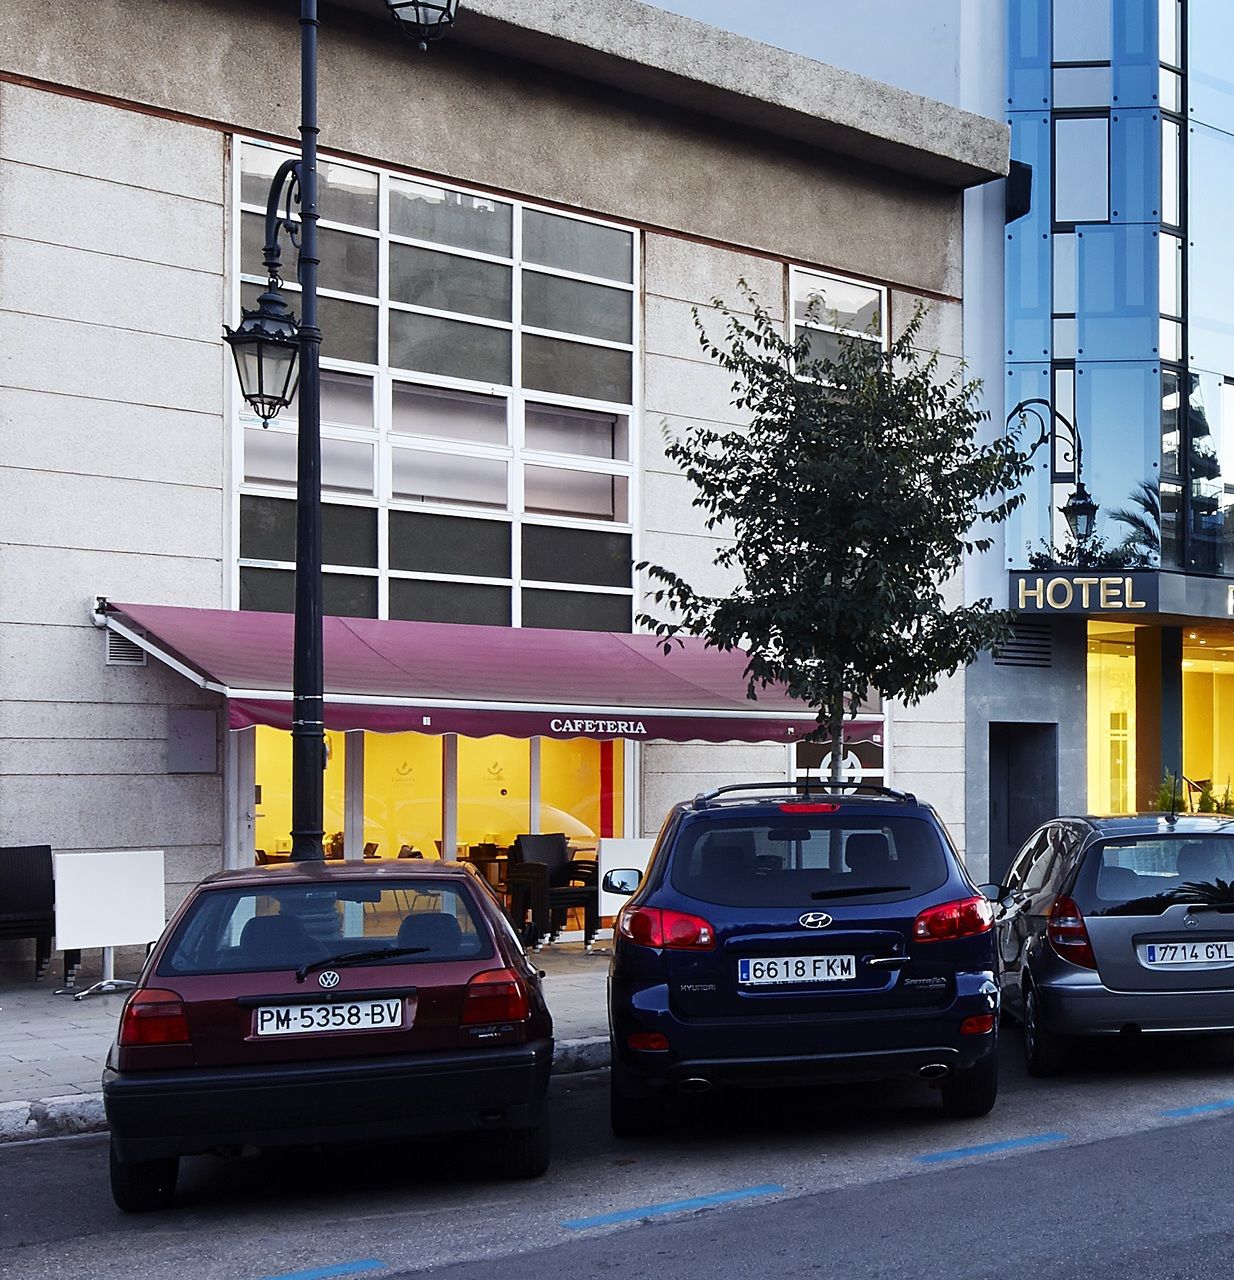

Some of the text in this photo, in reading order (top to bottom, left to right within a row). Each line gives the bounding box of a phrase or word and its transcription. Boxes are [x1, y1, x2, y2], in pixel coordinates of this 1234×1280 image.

[1017, 576, 1146, 609] HOTEL
[550, 719, 647, 734] CAFETERIA
[1159, 943, 1234, 961] 7714 GYL
[753, 957, 851, 979] 6618 FKM
[680, 984, 717, 992] HYUNDAI
